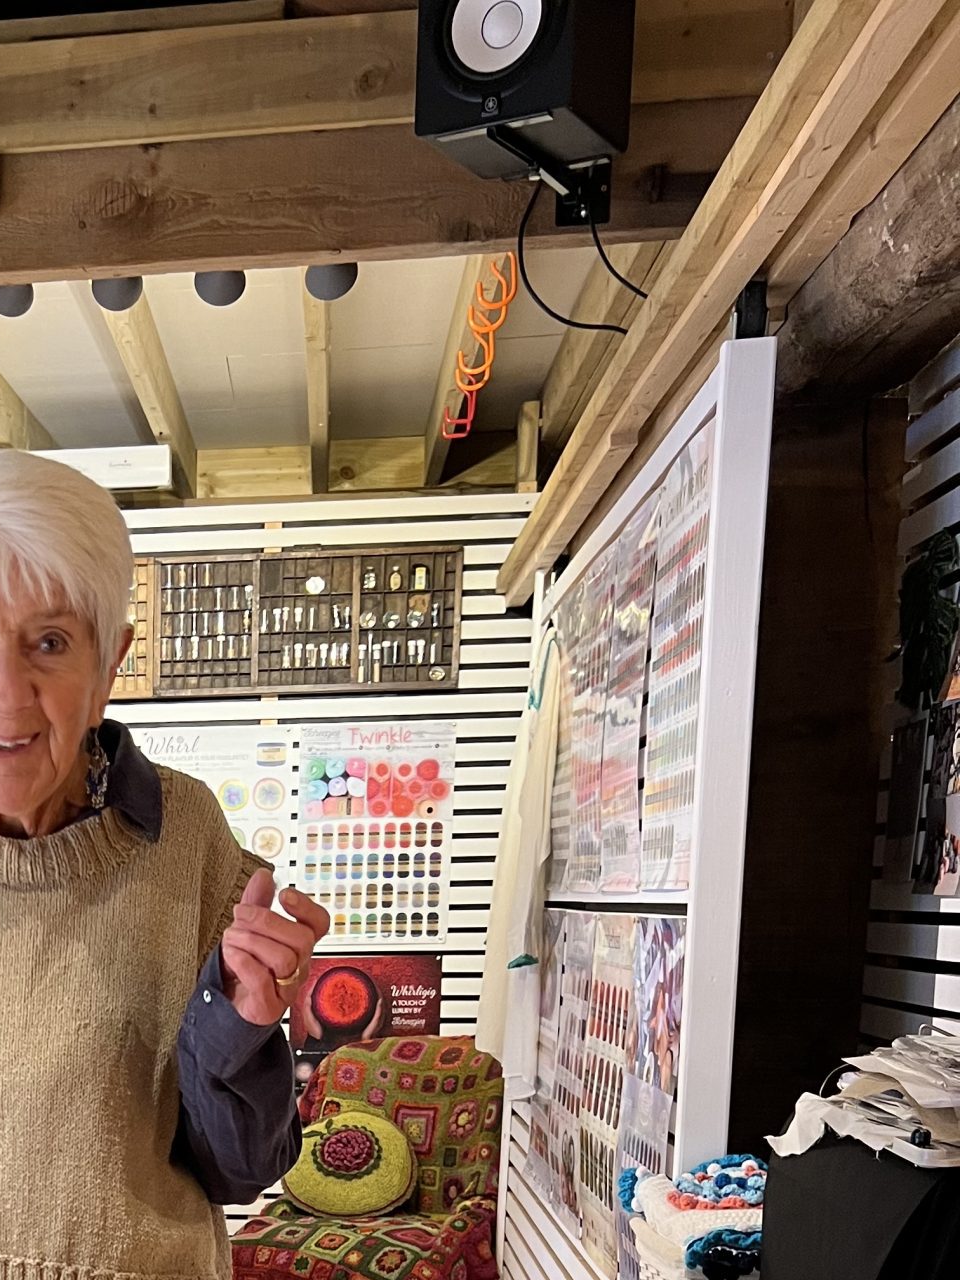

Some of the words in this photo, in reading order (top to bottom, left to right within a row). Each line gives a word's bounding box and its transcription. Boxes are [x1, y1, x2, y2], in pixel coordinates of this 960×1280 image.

[146, 735, 200, 755] Whirl
[347, 726, 414, 746] Twinkle
[391, 985, 436, 999] Whirligig
